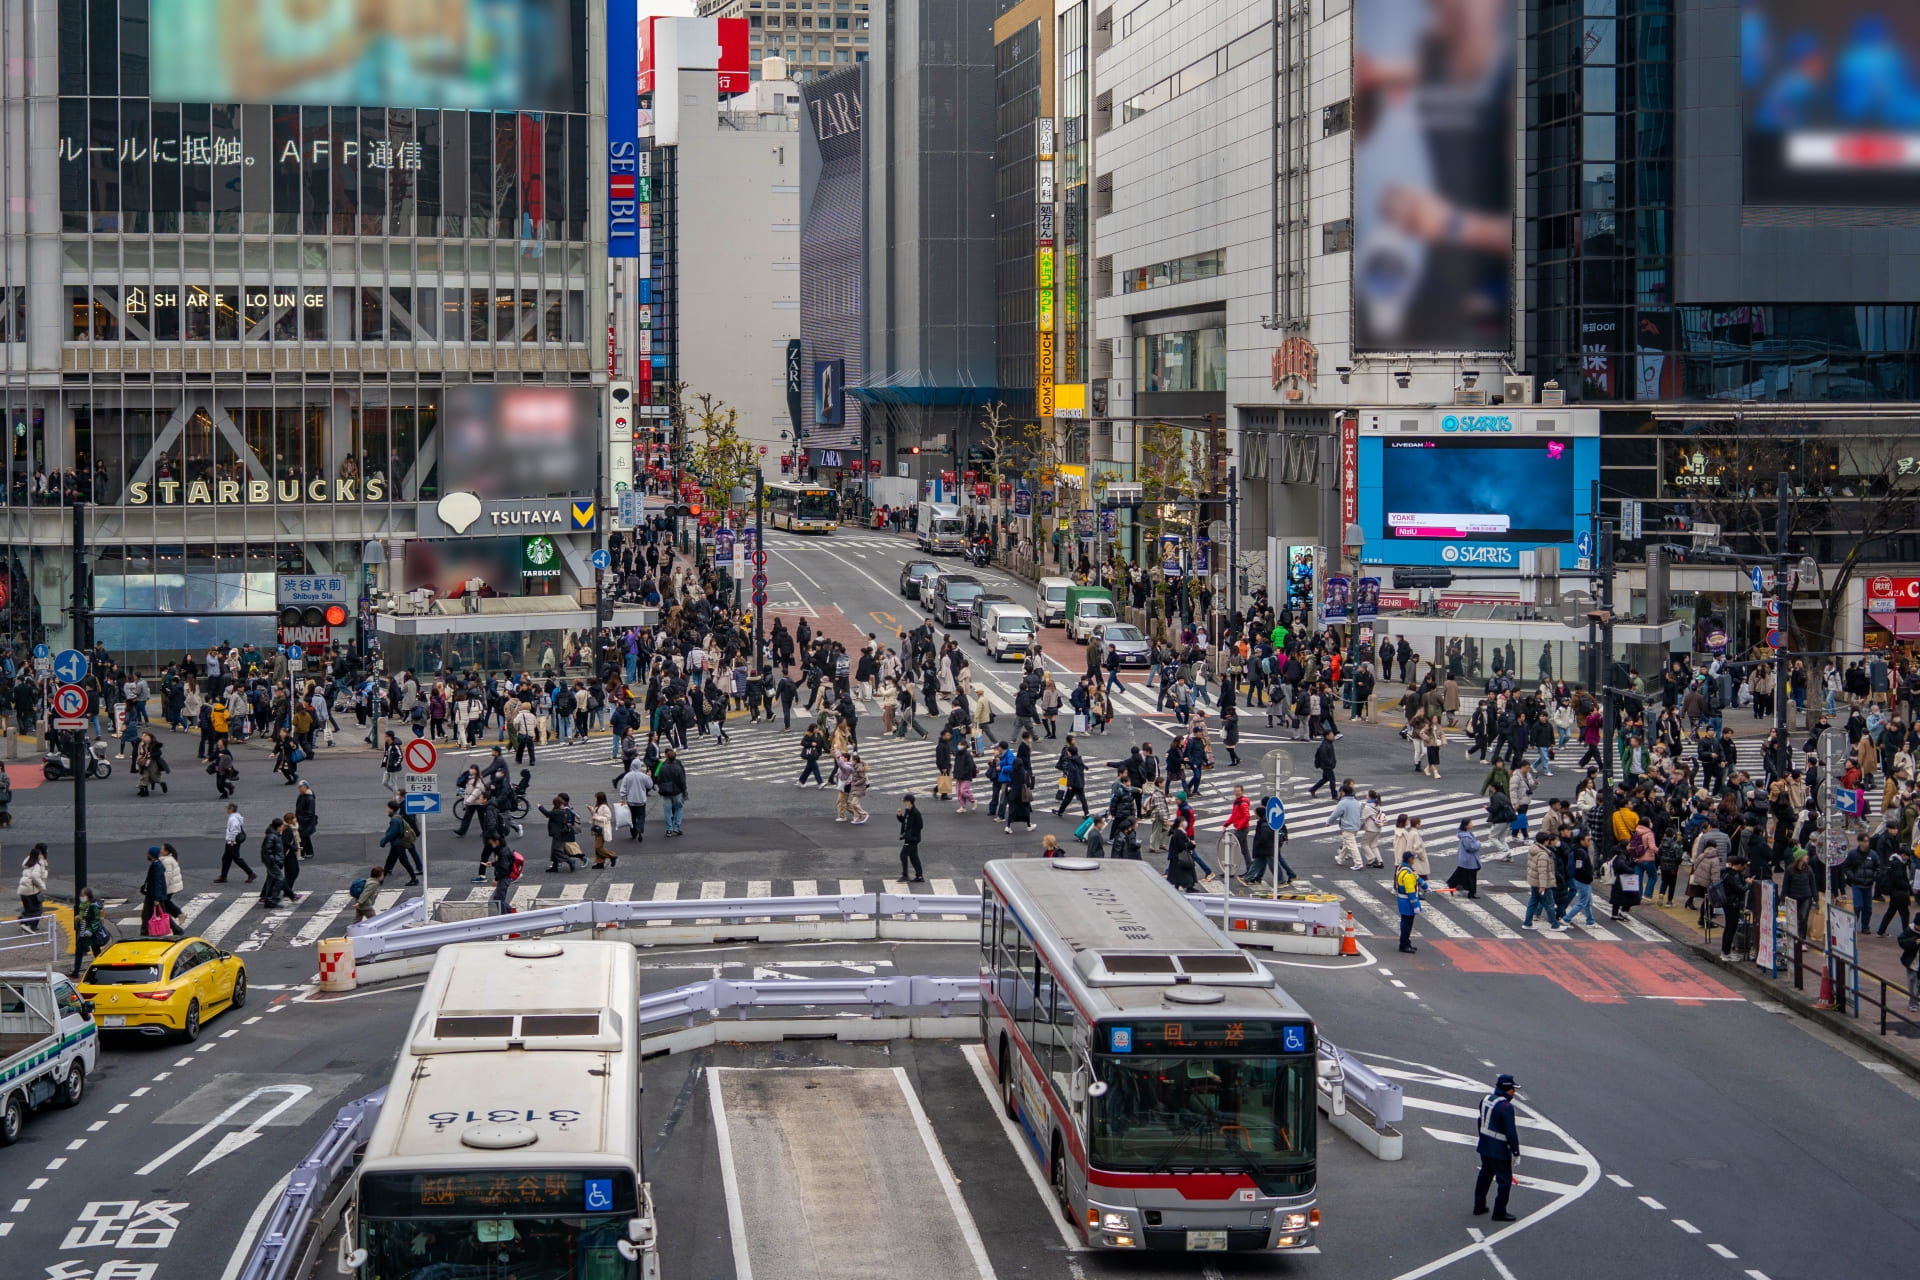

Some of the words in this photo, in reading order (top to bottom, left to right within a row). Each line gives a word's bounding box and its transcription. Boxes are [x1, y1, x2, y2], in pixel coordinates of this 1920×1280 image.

[811, 90, 862, 141] ZARA
[1041, 120, 1052, 153] 皮ふ科
[1041, 176, 1052, 200] 内科
[1041, 206, 1053, 239] 処方せん
[154, 293, 224, 307] SHARE
[245, 293, 325, 307] LOUNGE
[1042, 332, 1052, 373] TOUCH
[788, 347, 800, 393] ZARA
[1042, 376, 1052, 415] MOM'S
[1459, 415, 1513, 432] STARTS
[820, 450, 841, 467] ZARA
[130, 478, 383, 504] STARBUCKS
[1345, 444, 1354, 532] 天津甘
[1675, 475, 1721, 486] COFFEE
[490, 510, 562, 525] TSUTAYA
[1459, 546, 1512, 563] STARTS
[284, 578, 341, 592] 渋谷駅前
[292, 592, 320, 601] Shibuya
[282, 625, 329, 644] MARVEL
[428, 1109, 582, 1126] 31315
[487, 1174, 569, 1197] 渋谷駅
